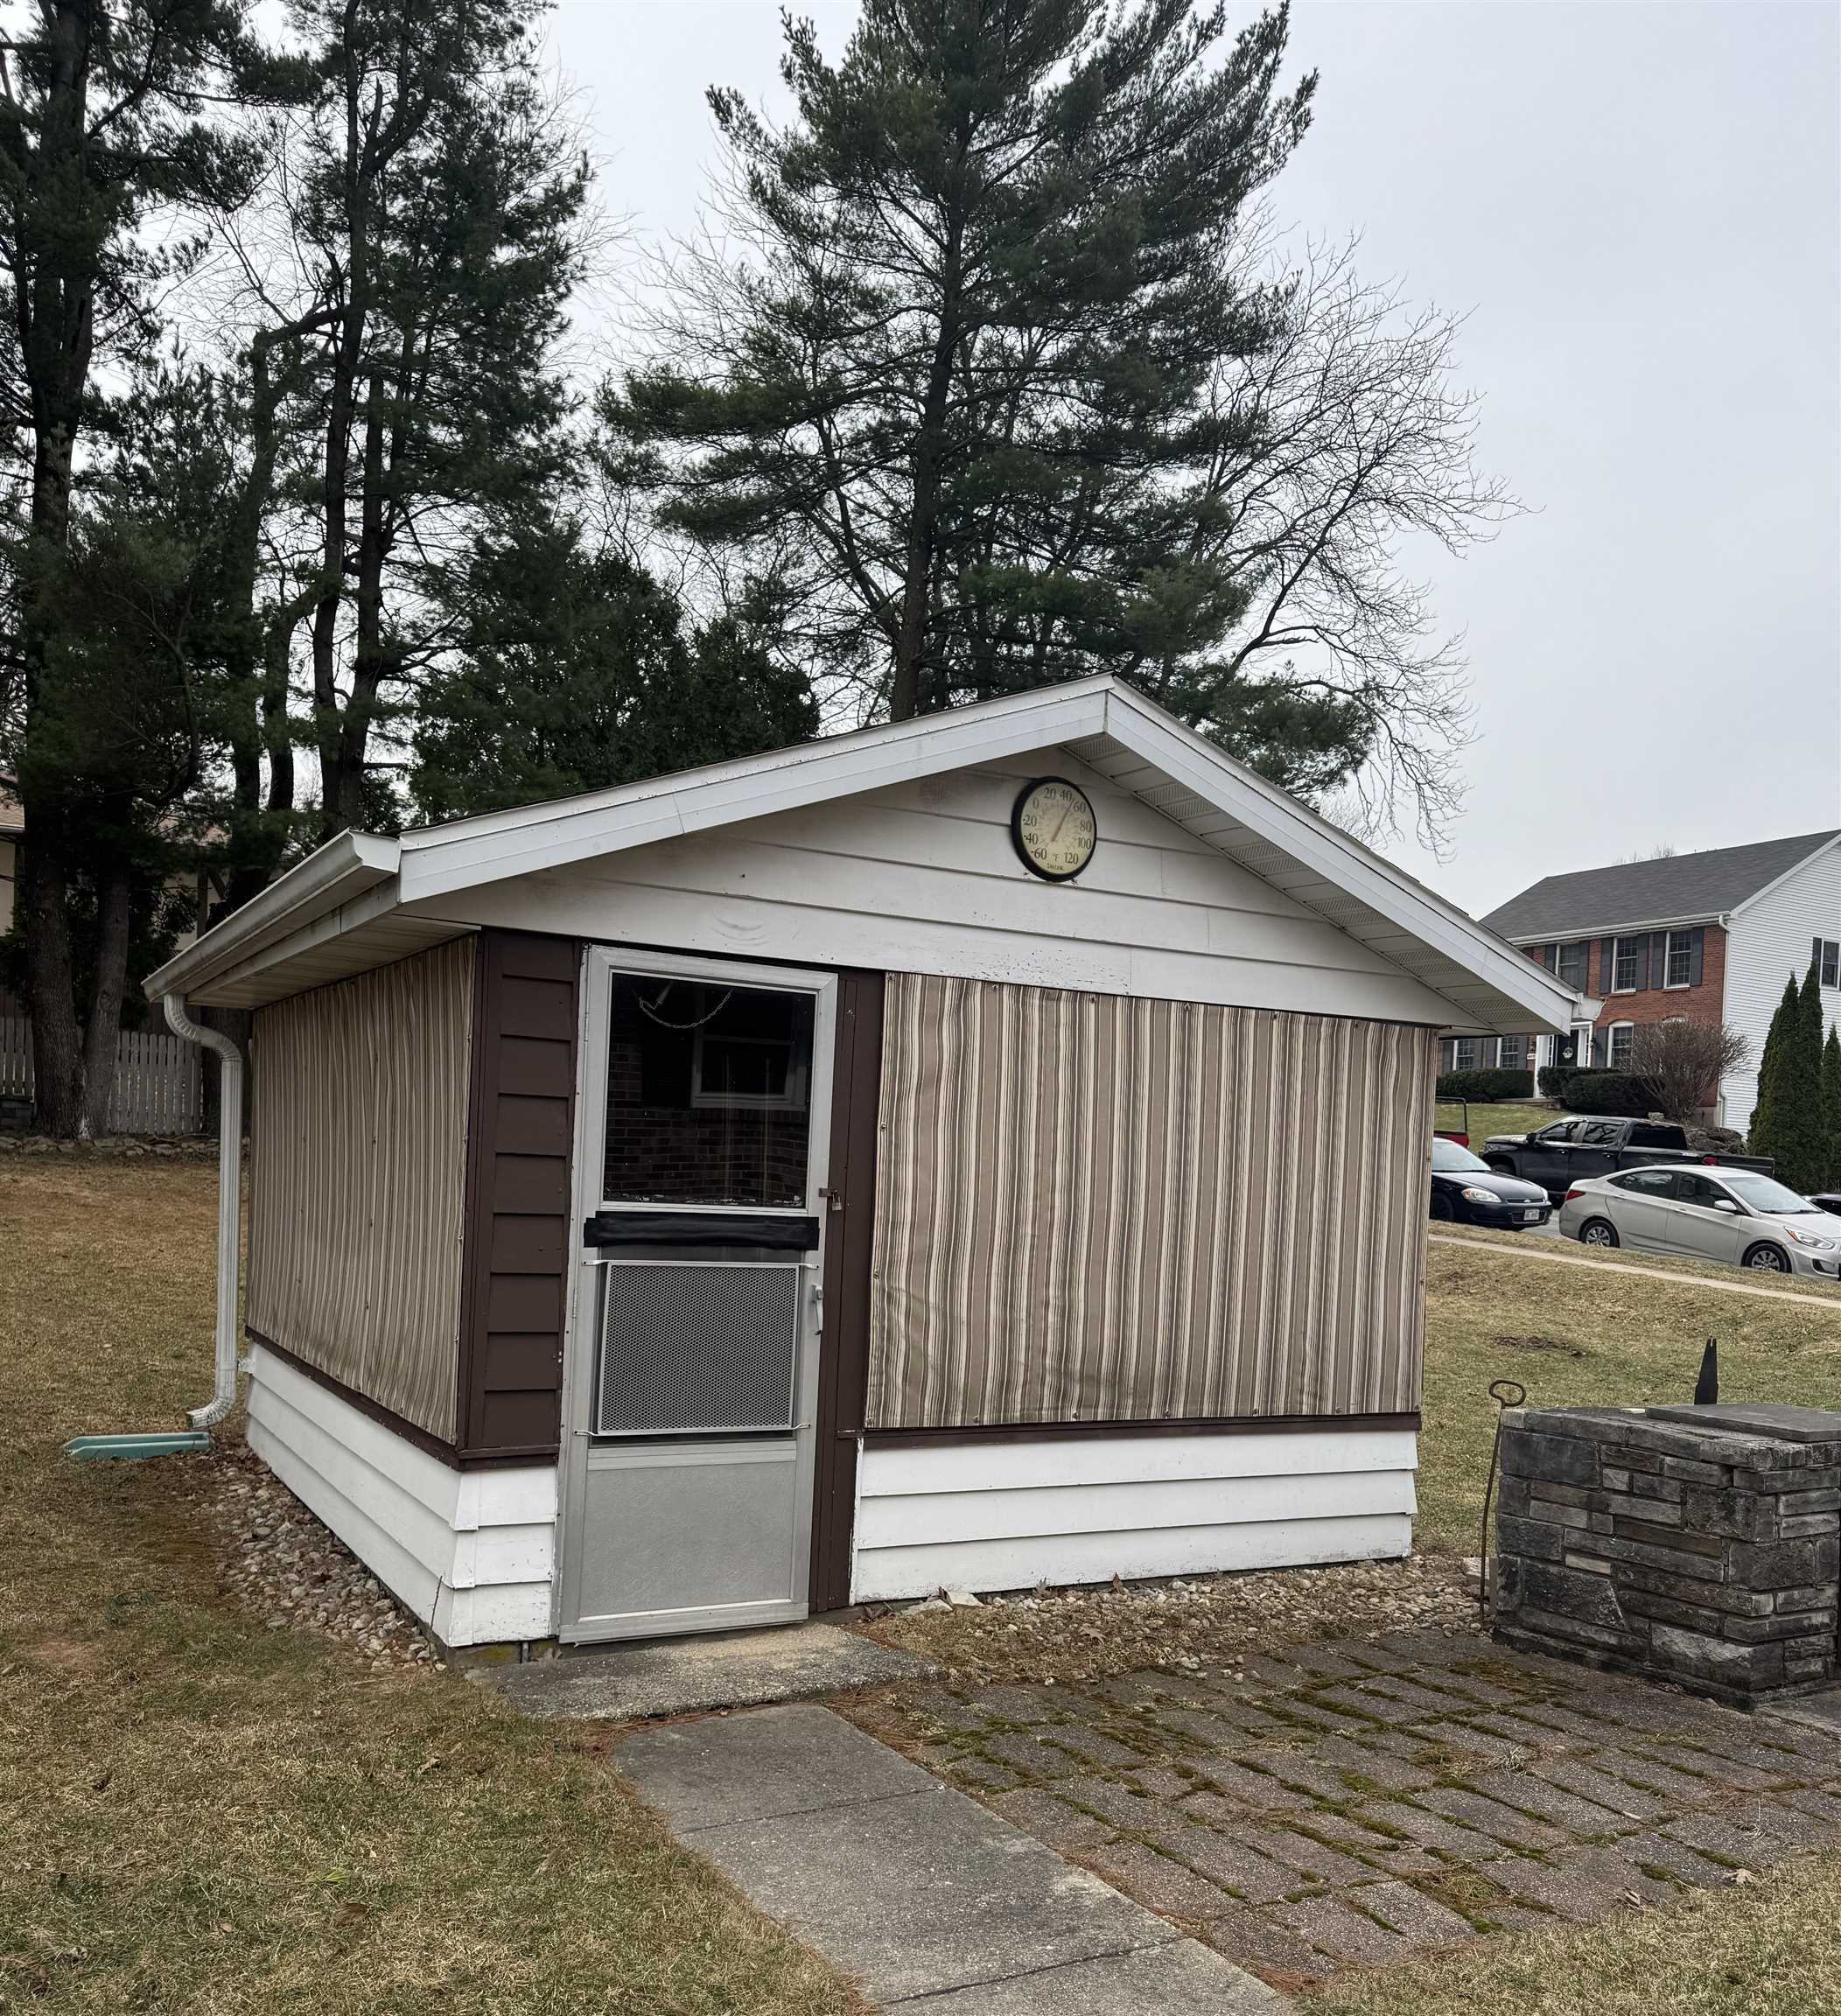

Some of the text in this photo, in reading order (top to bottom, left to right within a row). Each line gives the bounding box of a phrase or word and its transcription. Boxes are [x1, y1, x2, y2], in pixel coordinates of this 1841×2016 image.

[1044, 788, 1056, 799] 20
[1060, 790, 1072, 802] 40
[1032, 798, 1040, 809] 0
[1074, 802, 1086, 813] 60
[1079, 821, 1092, 833] 80
[1077, 837, 1092, 850] 100
[1064, 852, 1078, 864] 120
